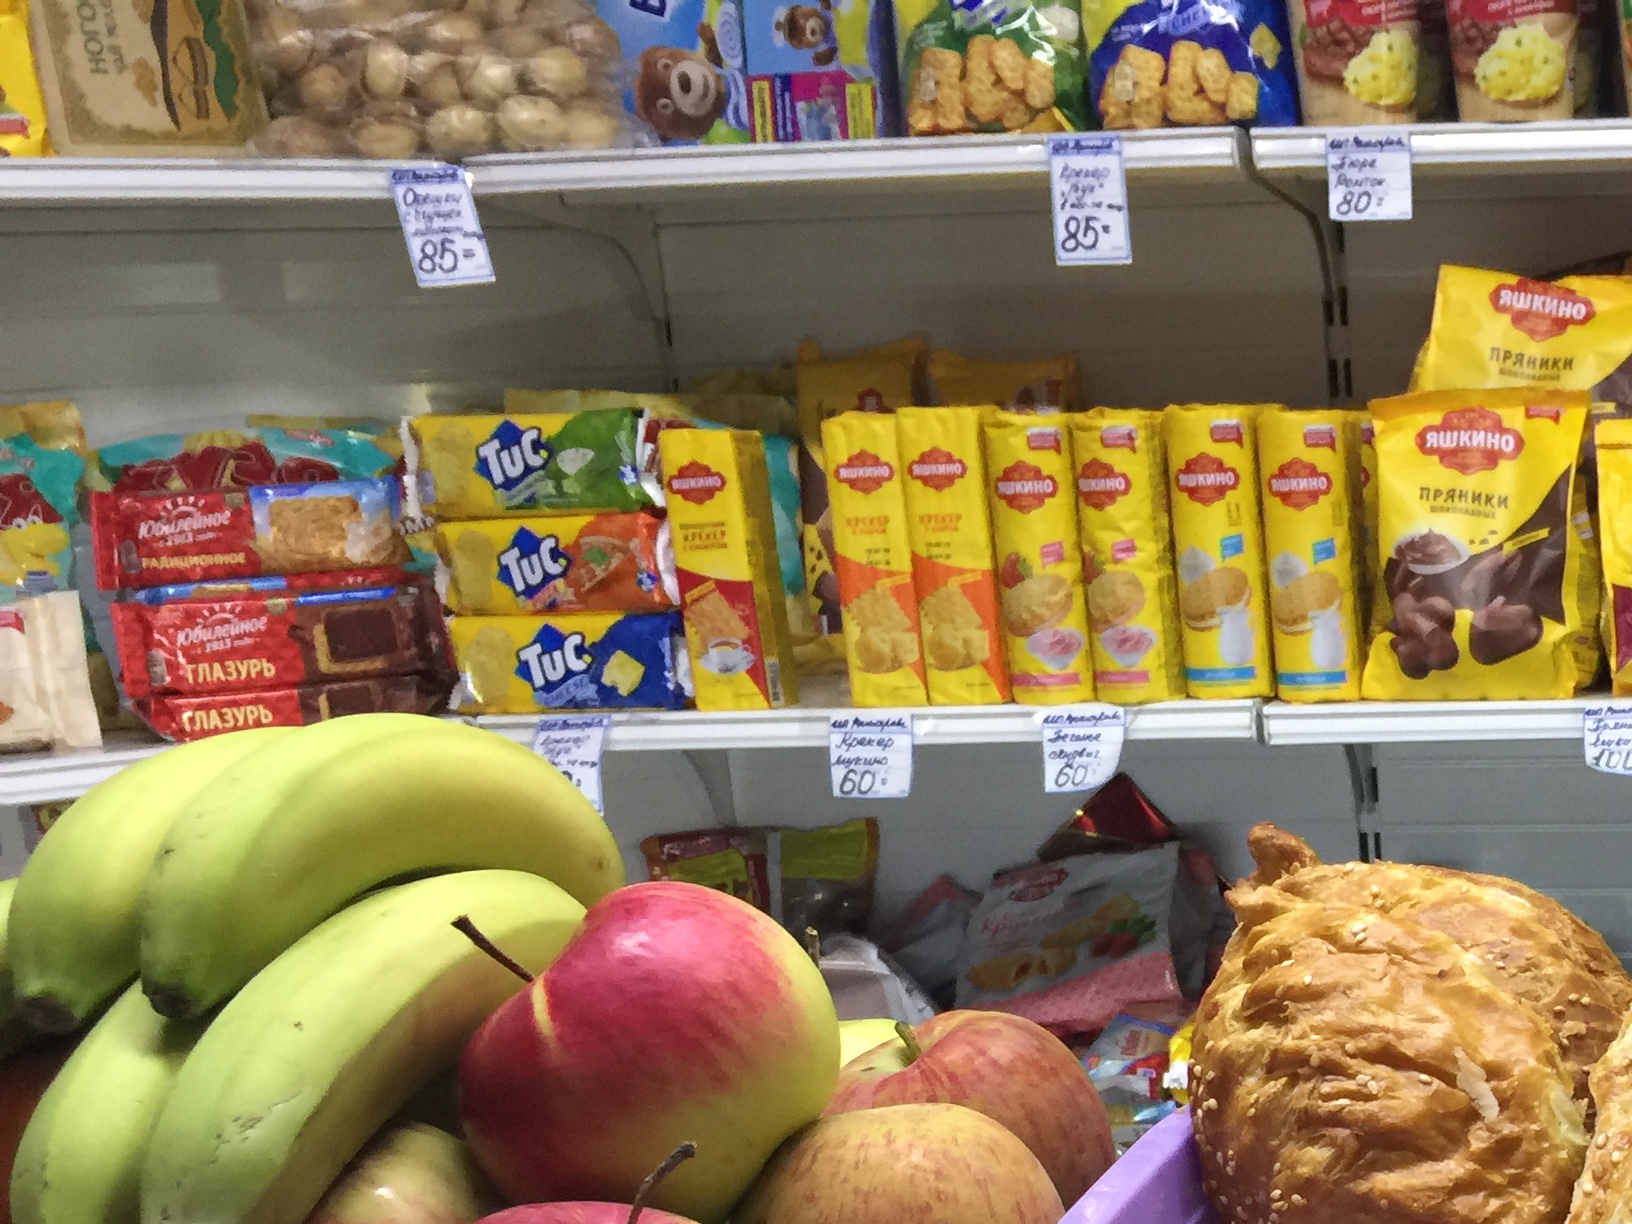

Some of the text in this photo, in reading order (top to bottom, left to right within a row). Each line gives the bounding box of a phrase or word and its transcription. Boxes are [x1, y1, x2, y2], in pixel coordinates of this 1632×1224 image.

[1498, 288, 1588, 320] ЯШКИНО
[1489, 346, 1575, 371] ПРЯНИКИ
[1425, 430, 1515, 453] ЯШКИНО
[1419, 487, 1509, 510] ПРЯНИКИ
[185, 657, 276, 684] ГЛАЗУРЬ
[181, 705, 274, 732] ГЛАЗУРЬ
